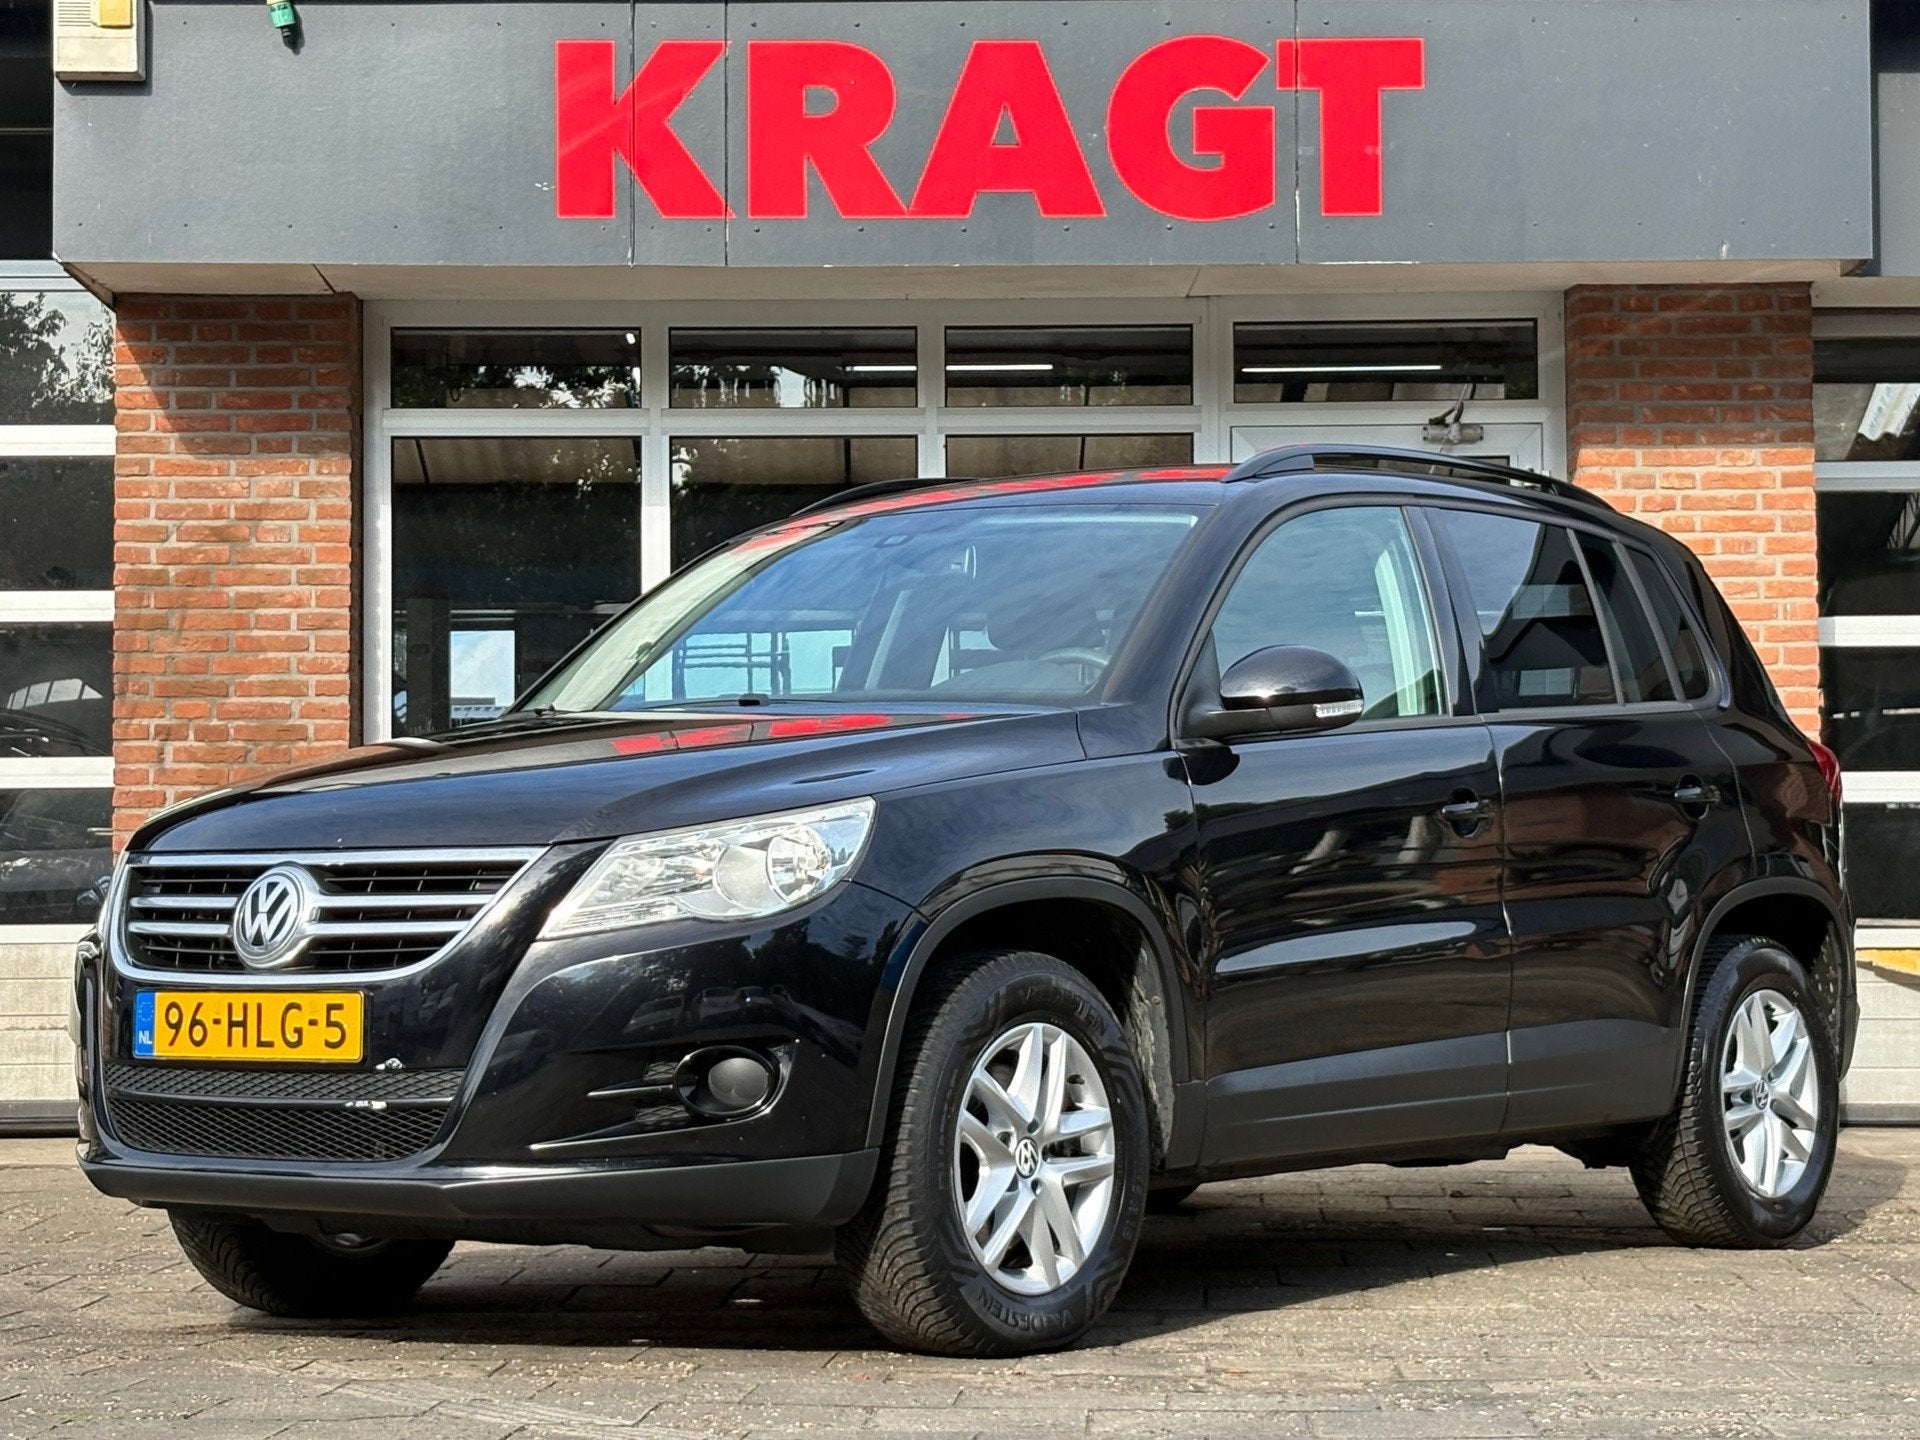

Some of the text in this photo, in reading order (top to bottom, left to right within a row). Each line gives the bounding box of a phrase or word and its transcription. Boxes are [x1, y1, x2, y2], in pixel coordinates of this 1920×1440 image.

[555, 35, 1426, 221] KRAGT
[139, 1030, 153, 1045] NL
[164, 1001, 347, 1050] 96-HLG-5
